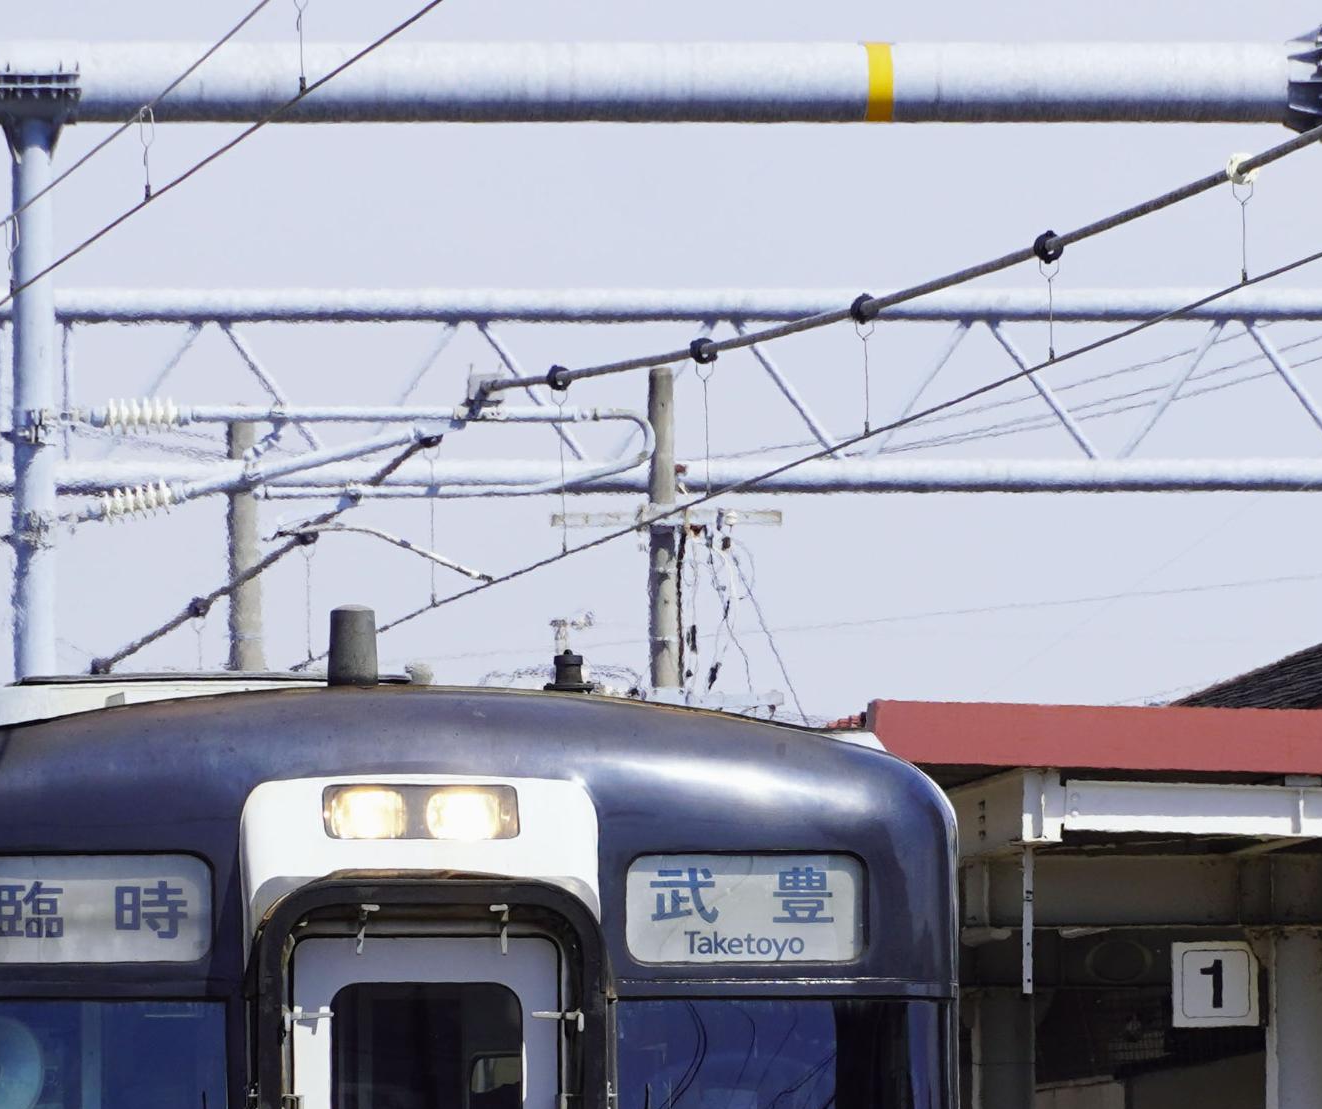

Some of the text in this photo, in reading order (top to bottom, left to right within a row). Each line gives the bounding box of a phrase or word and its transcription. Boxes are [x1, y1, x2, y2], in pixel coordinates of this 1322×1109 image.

[649, 866, 835, 925] 武豊
[684, 931, 806, 961] Taketoyo
[1199, 958, 1224, 1009] 1
